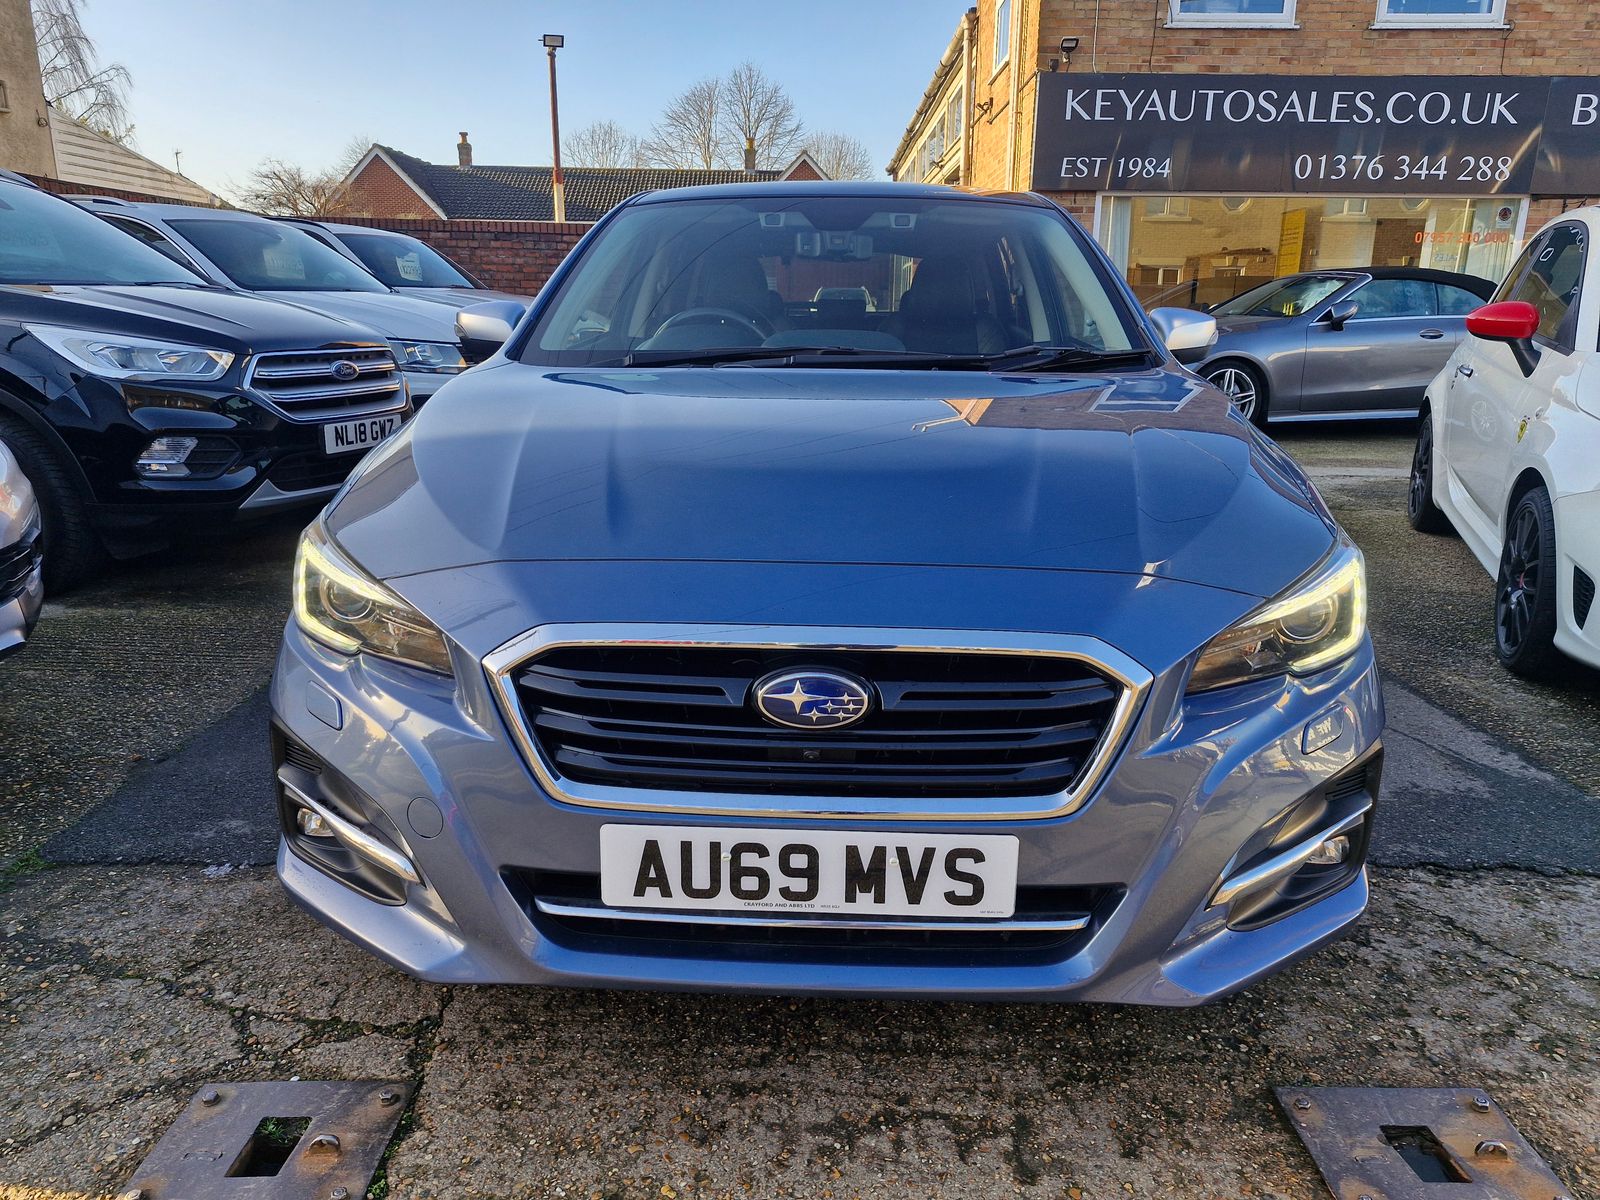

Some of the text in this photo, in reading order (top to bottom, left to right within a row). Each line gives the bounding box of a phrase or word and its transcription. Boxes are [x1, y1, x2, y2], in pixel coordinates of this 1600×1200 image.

[1064, 88, 1519, 126] KEYAUTOSALES.CO.UK
[1060, 157, 1171, 178] EST 1984
[1294, 154, 1513, 182] 01376 344 288
[340, 364, 354, 375] Ford
[334, 422, 367, 447] NL18
[633, 839, 986, 906] AU69 MVS
